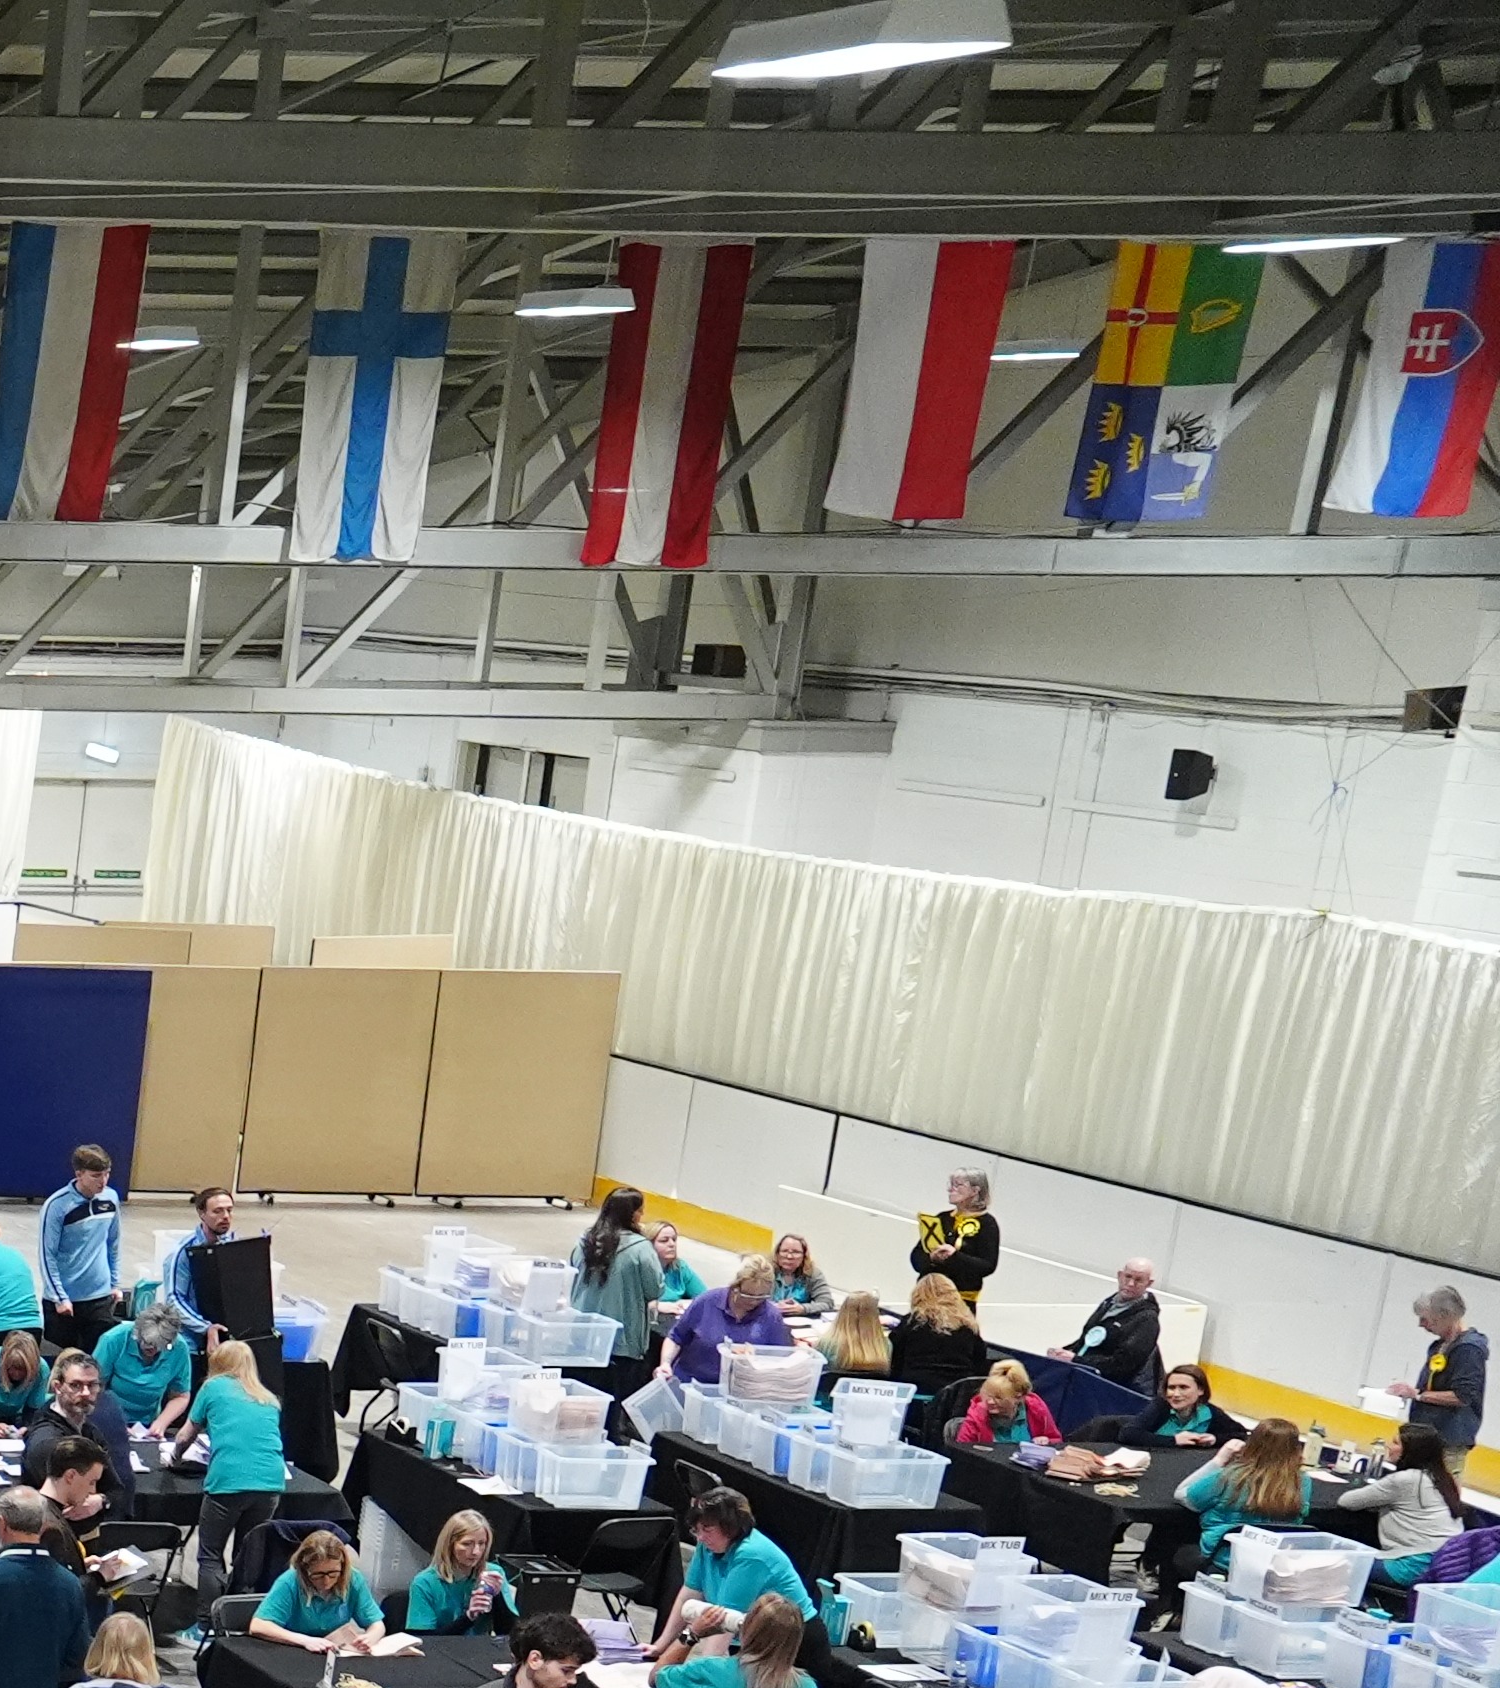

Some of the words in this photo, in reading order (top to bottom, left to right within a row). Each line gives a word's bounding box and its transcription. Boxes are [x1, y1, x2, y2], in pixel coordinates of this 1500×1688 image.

[450, 1341, 465, 1350] MIX
[466, 1341, 484, 1350] TUB
[852, 1386, 870, 1395] MIX
[872, 1388, 894, 1397] TUB
[1340, 1449, 1353, 1463] 25
[1244, 1529, 1260, 1542] MIX
[1261, 1533, 1279, 1547] TUB
[980, 1540, 997, 1550] MIX
[1000, 1540, 1021, 1550] TUB
[1089, 1591, 1111, 1603] MIX
[1112, 1591, 1134, 1603] TUB
[1456, 1666, 1483, 1684] CLARK
